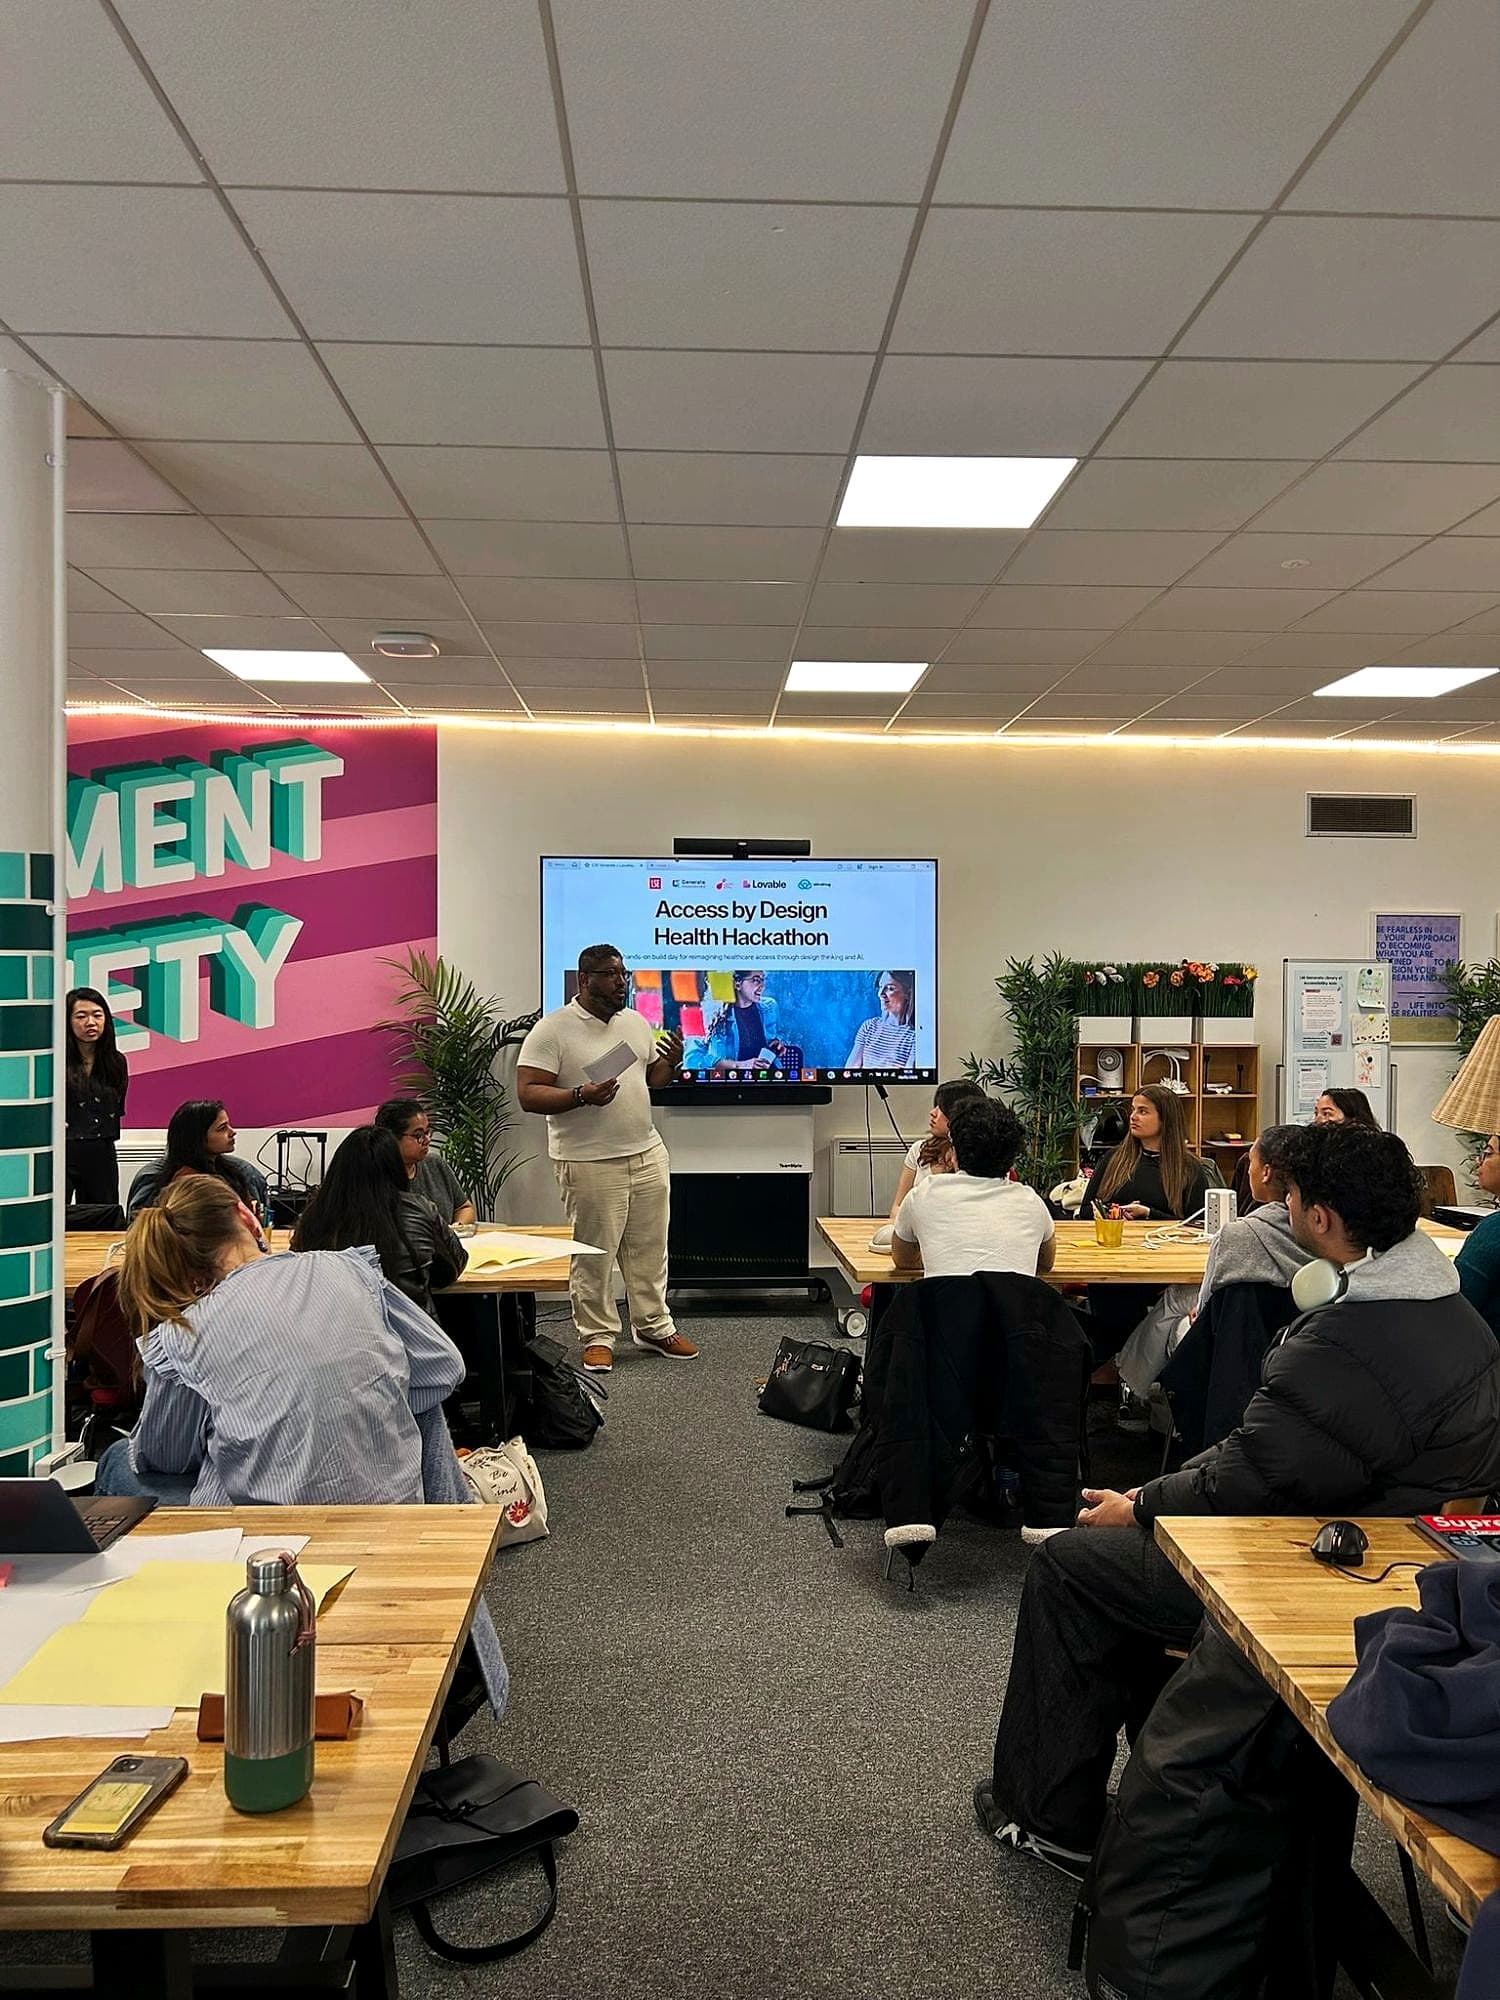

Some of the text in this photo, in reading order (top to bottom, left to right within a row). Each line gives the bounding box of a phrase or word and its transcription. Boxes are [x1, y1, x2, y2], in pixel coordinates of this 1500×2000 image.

[650, 878, 661, 889] LSE
[752, 879, 787, 889] Lovable
[656, 900, 828, 923] Access by Design
[1387, 926, 1423, 934] FEARLESS
[1425, 926, 1433, 934] IN
[655, 927, 829, 945] Health Hackathon
[1385, 934, 1456, 942] YOUR APPROACH
[1388, 942, 1432, 950] BECOMING
[652, 952, 666, 960] build
[667, 953, 678, 961] day
[777, 953, 800, 961] through
[800, 953, 820, 961] design
[1401, 950, 1418, 958] YOU
[1419, 950, 1434, 958] ARE
[1434, 958, 1445, 966] TO
[1415, 966, 1437, 974] YOUR
[66, 912, 303, 1054] ETY
[1409, 1001, 1425, 1009] LIFE
[1426, 1001, 1446, 1009] INTO
[1401, 1009, 1438, 1017] REALITIES
